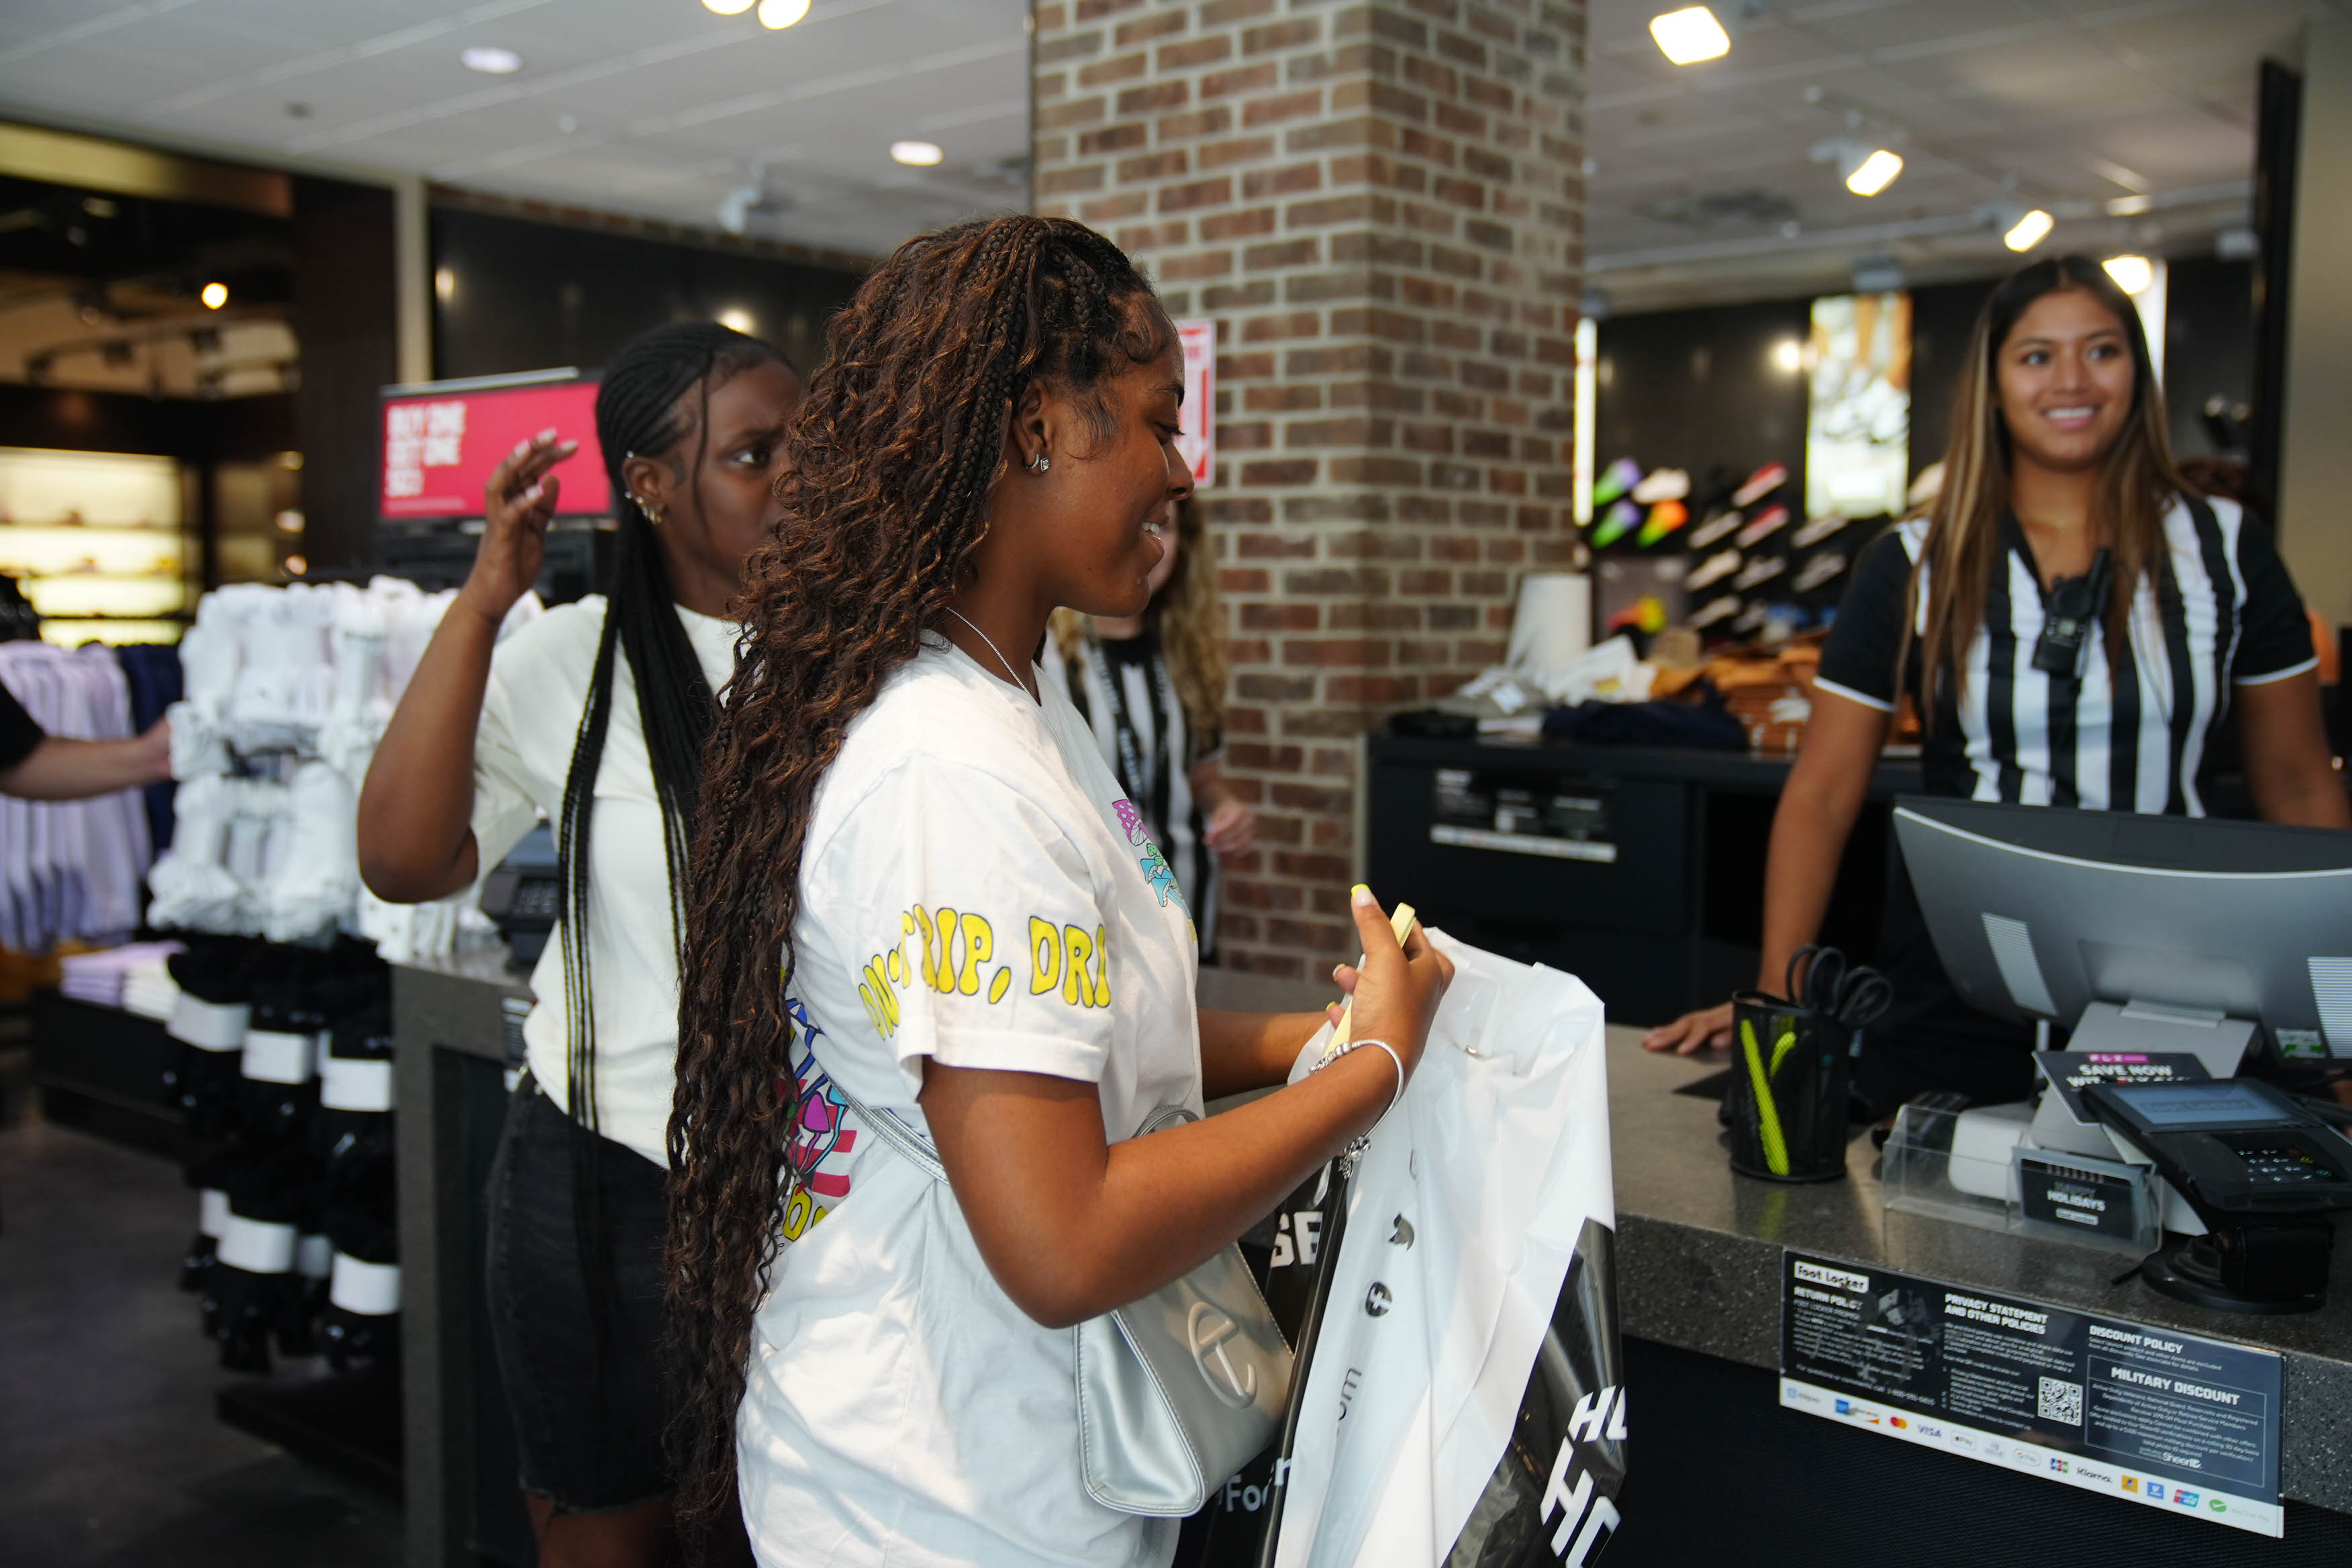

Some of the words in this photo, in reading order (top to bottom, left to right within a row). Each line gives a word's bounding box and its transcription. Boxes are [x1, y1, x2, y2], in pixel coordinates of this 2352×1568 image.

[2079, 1065, 2127, 1077] SAVE
[2128, 1065, 2173, 1077] NOW
[2047, 1189, 2105, 1212] HOLIDAYS
[1798, 1265, 1822, 1280] Foot
[1826, 1272, 1865, 1290] Locker
[1794, 1286, 1830, 1304] RETURN
[1945, 1293, 1989, 1311] PRIVACY
[1989, 1304, 2049, 1324] STATEMENT
[1945, 1304, 1967, 1317] AND
[1967, 1309, 2000, 1325] OTHER
[2002, 1316, 2046, 1335] POLICIES
[2090, 1325, 2143, 1344] DISCOUNT
[2143, 1337, 2184, 1354] POLICY
[2111, 1367, 2173, 1390] MILITARY
[2173, 1381, 2241, 1406] DISCOUNT
[1917, 1424, 1941, 1438] VISA
